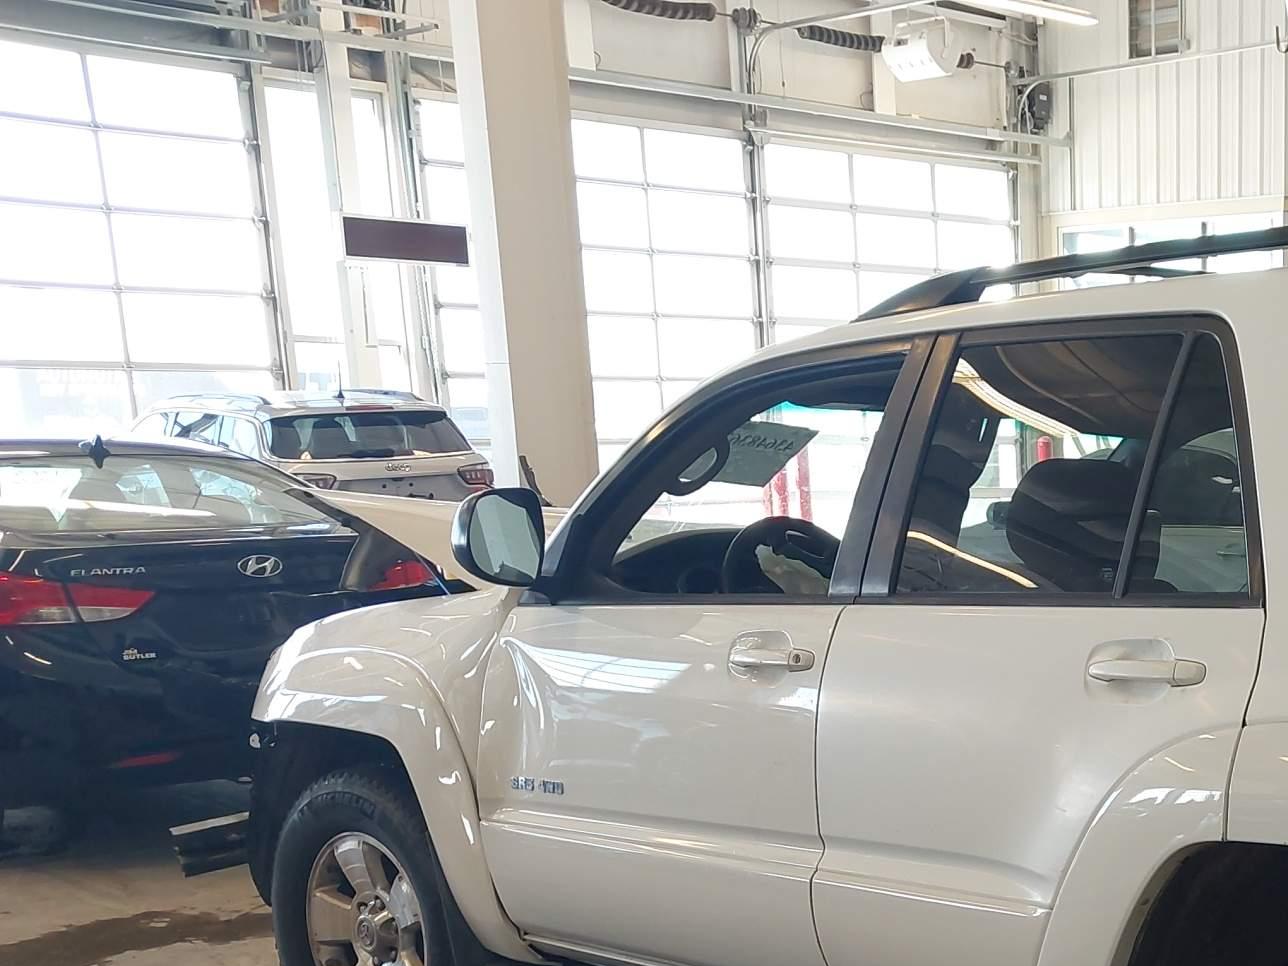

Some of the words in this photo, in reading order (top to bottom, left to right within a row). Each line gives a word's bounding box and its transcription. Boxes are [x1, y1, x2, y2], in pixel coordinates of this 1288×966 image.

[70, 566, 146, 577] ELANTRA
[511, 776, 536, 791] SR5
[537, 779, 565, 795] 4WD
